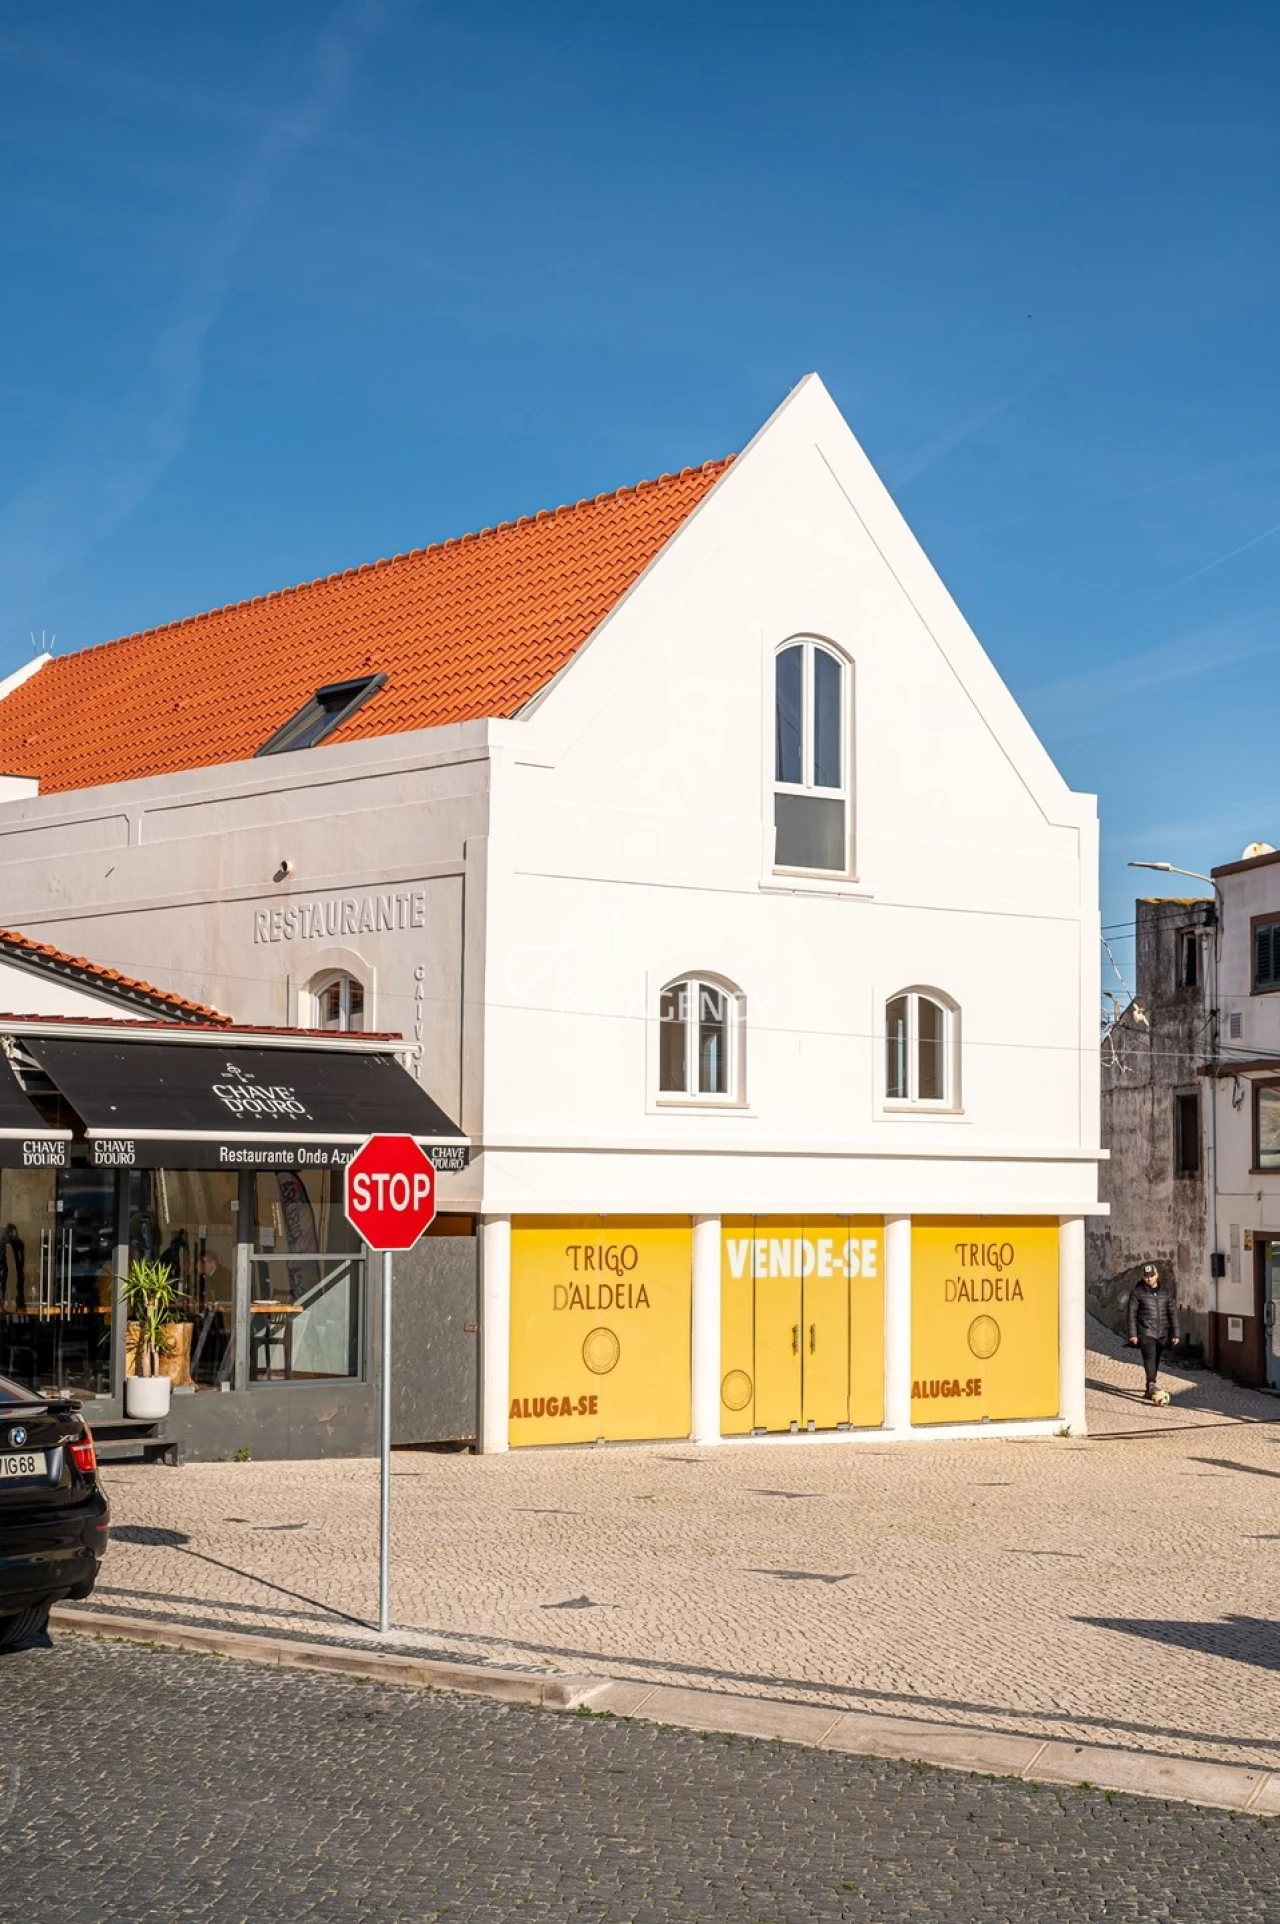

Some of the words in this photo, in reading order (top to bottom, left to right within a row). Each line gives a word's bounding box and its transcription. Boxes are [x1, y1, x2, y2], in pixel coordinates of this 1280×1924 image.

[253, 891, 426, 943] RESTAURANTE
[221, 1098, 306, 1114] D'OURO
[23, 1140, 65, 1153] CHAVE
[94, 1140, 135, 1153] CHAVE
[220, 1146, 294, 1163] Restaurante
[297, 1148, 328, 1164] Onda
[432, 1147, 466, 1158] CHAVE
[23, 1152, 65, 1166] D'OURO
[94, 1152, 136, 1165] D'OURO
[352, 1172, 431, 1212] STOP
[565, 1244, 639, 1277] TRIGO
[726, 1238, 878, 1279] VENDE-SE
[954, 1242, 1015, 1272] TRIGO
[552, 1281, 651, 1311] D'ALDEIA
[944, 1276, 1025, 1303] D'ALDEIA
[911, 1378, 983, 1399] ALUGA-SE
[509, 1395, 599, 1419] ALUGA-SE
